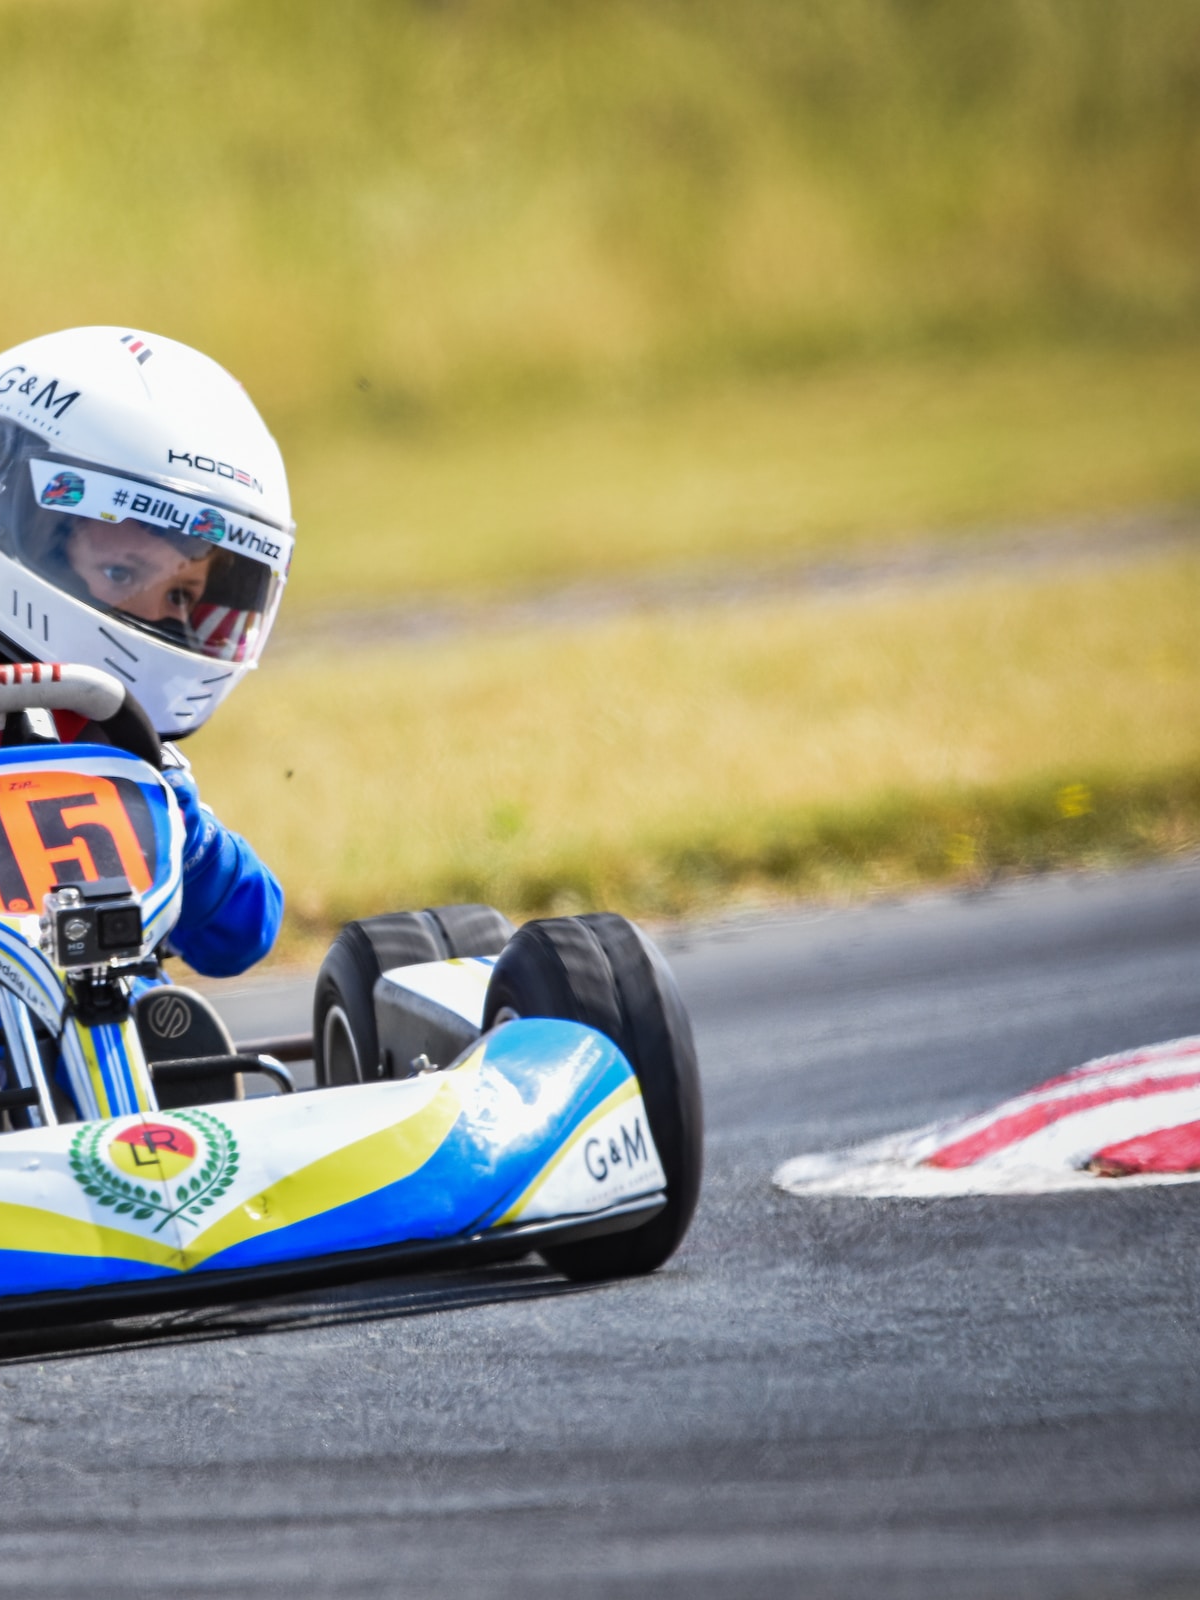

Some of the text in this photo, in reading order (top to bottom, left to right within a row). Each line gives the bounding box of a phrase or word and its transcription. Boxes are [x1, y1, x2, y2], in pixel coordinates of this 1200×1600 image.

[167, 449, 263, 495] KODEN
[112, 488, 282, 560] #Billy Whizz
[67, 942, 85, 951] HD
[584, 1116, 648, 1182] G&M
